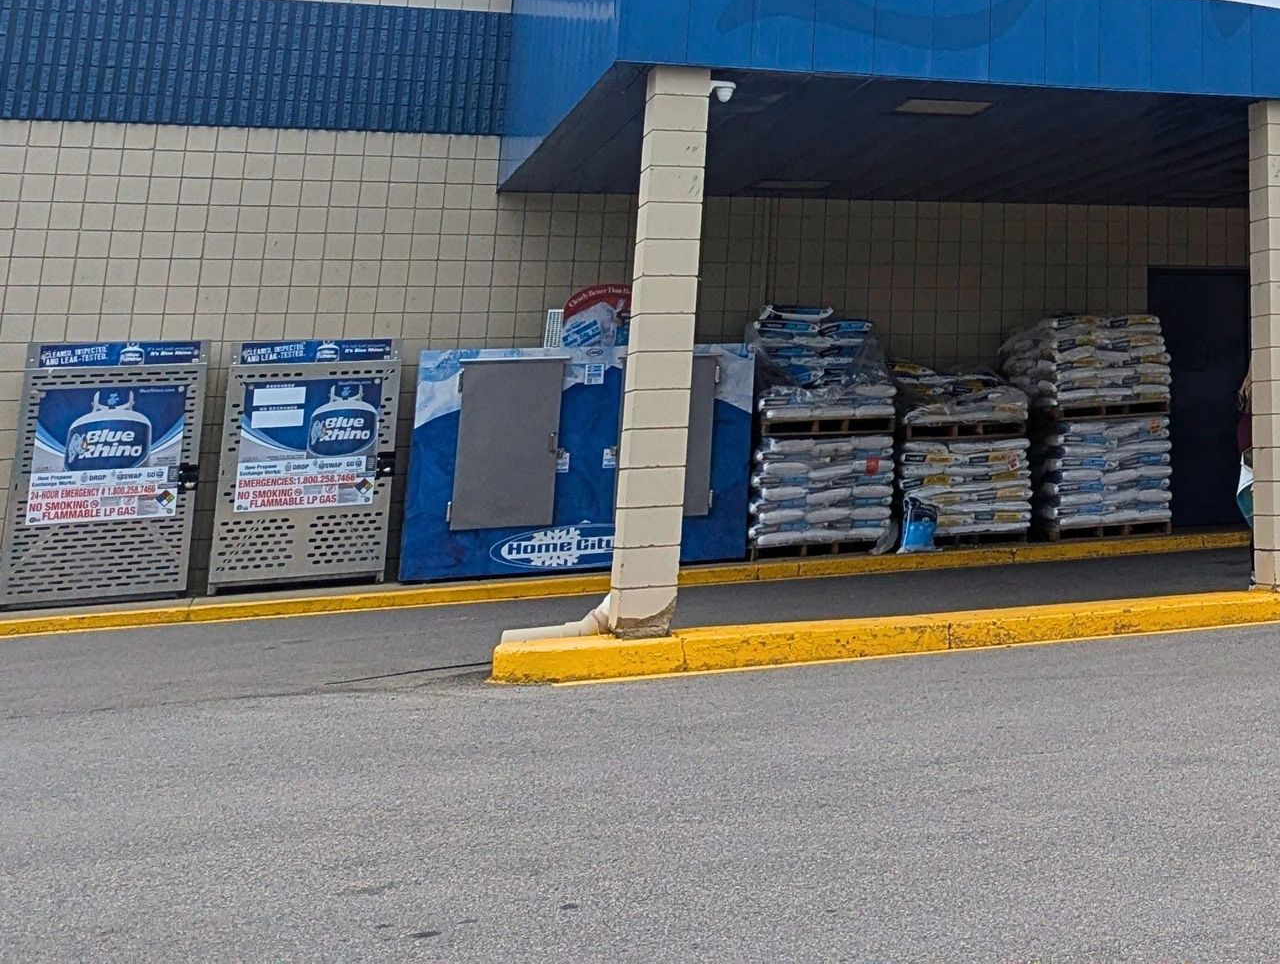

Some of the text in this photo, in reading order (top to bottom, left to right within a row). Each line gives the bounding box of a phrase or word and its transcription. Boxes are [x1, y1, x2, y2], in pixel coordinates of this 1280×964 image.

[324, 416, 365, 428] Blue
[85, 428, 135, 443] Blue
[319, 428, 370, 442] Rhino
[78, 442, 142, 459] Rhino
[30, 489, 60, 500] 24-HOUR
[60, 487, 100, 499] EMERGENCY
[237, 490, 250, 500] NO
[251, 488, 294, 499] SMOKING
[29, 502, 43, 512] NO
[44, 499, 89, 511] SMOKING
[249, 496, 305, 509] FLAMMABLE
[306, 495, 318, 505] LP
[319, 494, 337, 504] GAS
[42, 508, 101, 521] FLAMMABLE
[103, 507, 116, 517] LP
[117, 506, 136, 516] GAS
[507, 540, 573, 556] Home
